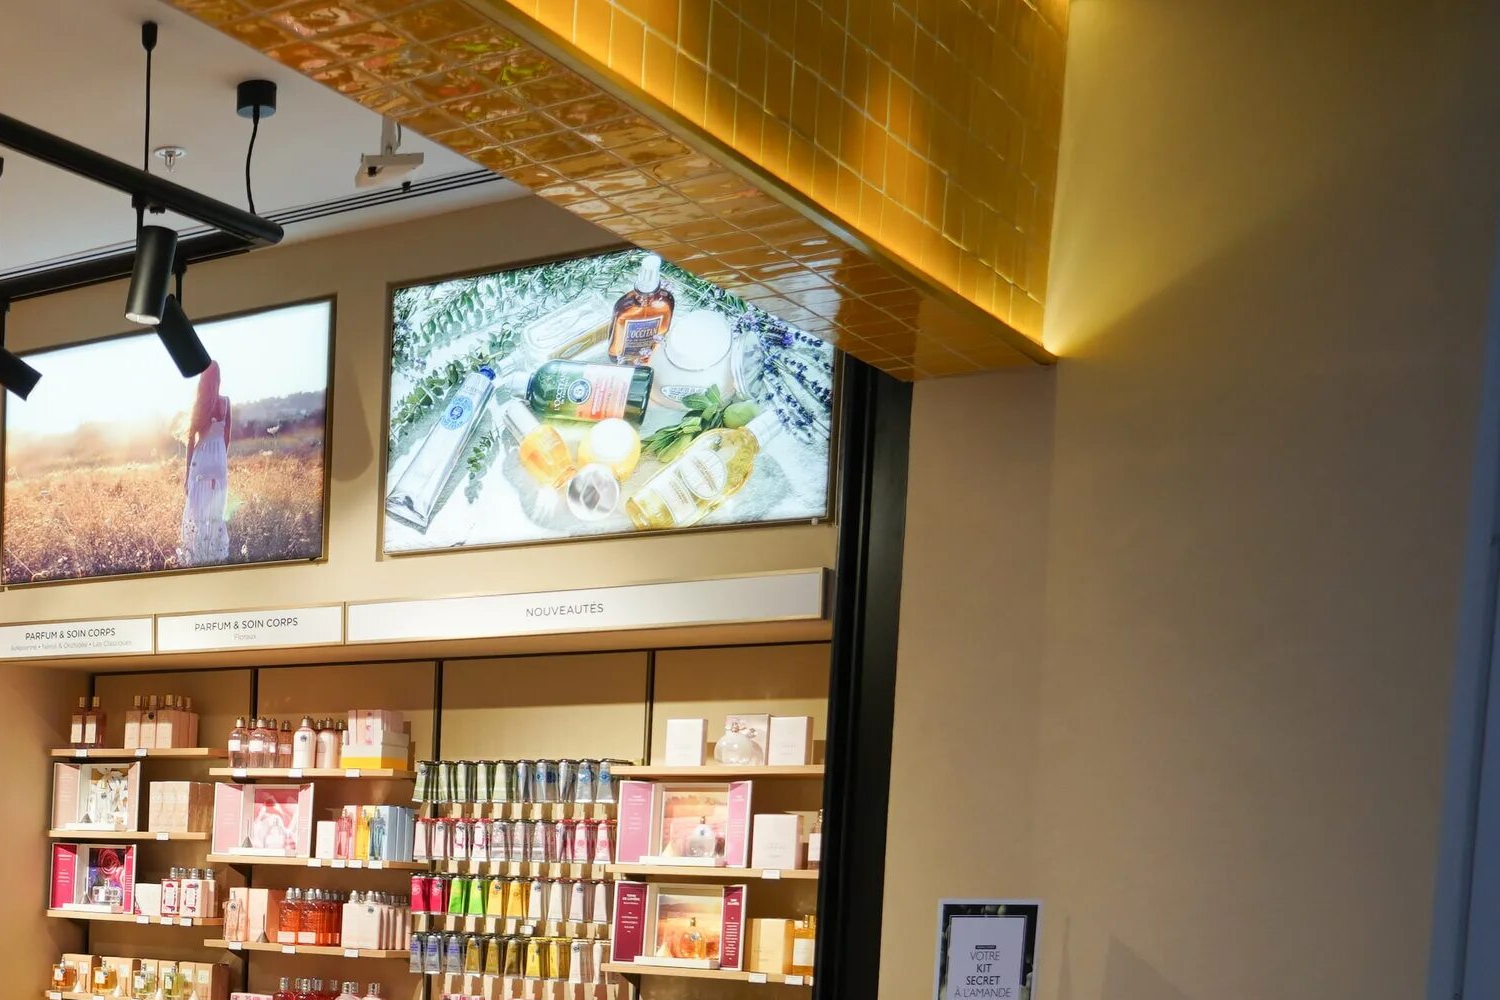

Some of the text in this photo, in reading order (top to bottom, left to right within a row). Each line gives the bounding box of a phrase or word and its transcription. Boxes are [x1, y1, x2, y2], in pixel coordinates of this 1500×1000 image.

[525, 602, 604, 617] NOUVEAUTÉS
[195, 617, 298, 632] PARFUM & SOIN CORPS
[25, 627, 116, 641] PARFUM & SOIN CORPS
[970, 951, 1000, 961] VOTRE
[976, 964, 993, 973] KIT
[966, 976, 1000, 985] SECRET
[954, 986, 1012, 998] À L'AMANDE
